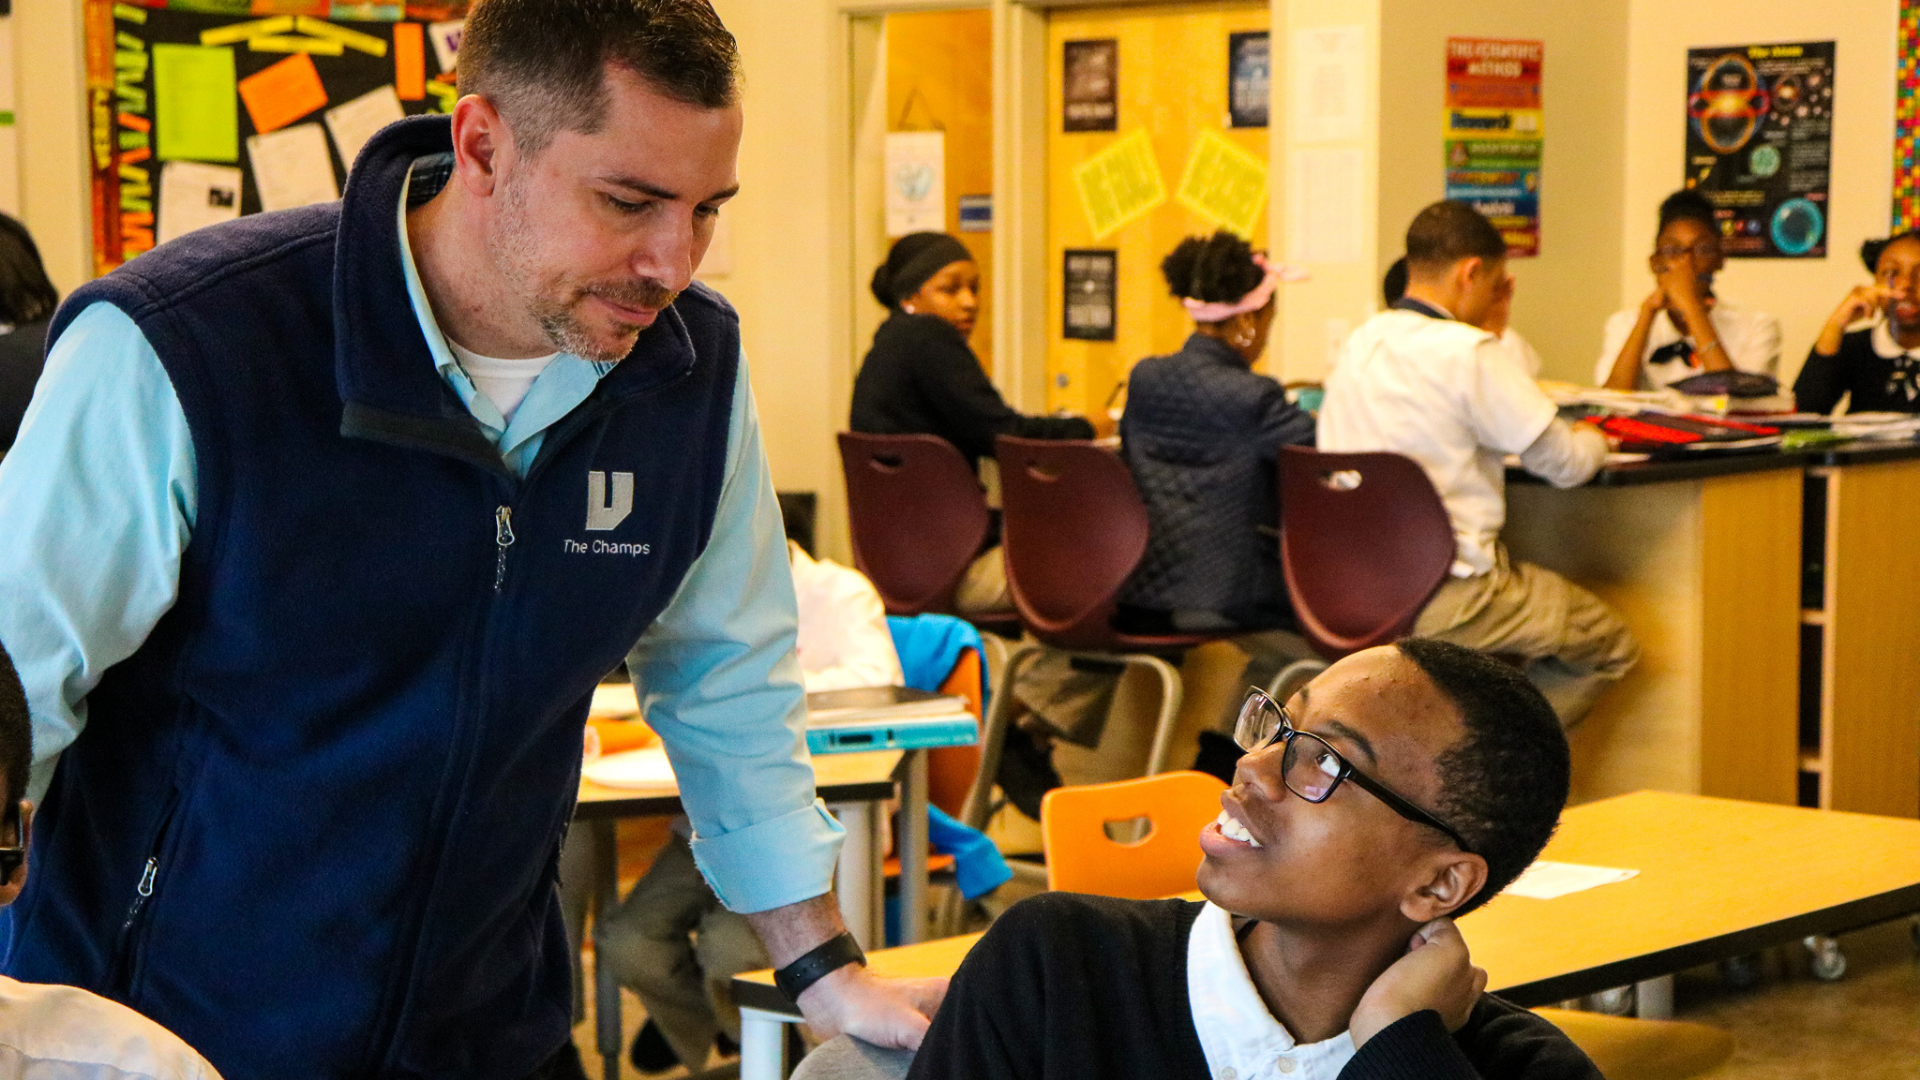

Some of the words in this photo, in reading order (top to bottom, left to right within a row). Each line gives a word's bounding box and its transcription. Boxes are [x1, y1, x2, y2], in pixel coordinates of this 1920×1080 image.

[585, 471, 634, 530] U
[564, 539, 588, 553] The
[592, 540, 650, 556] Champs
